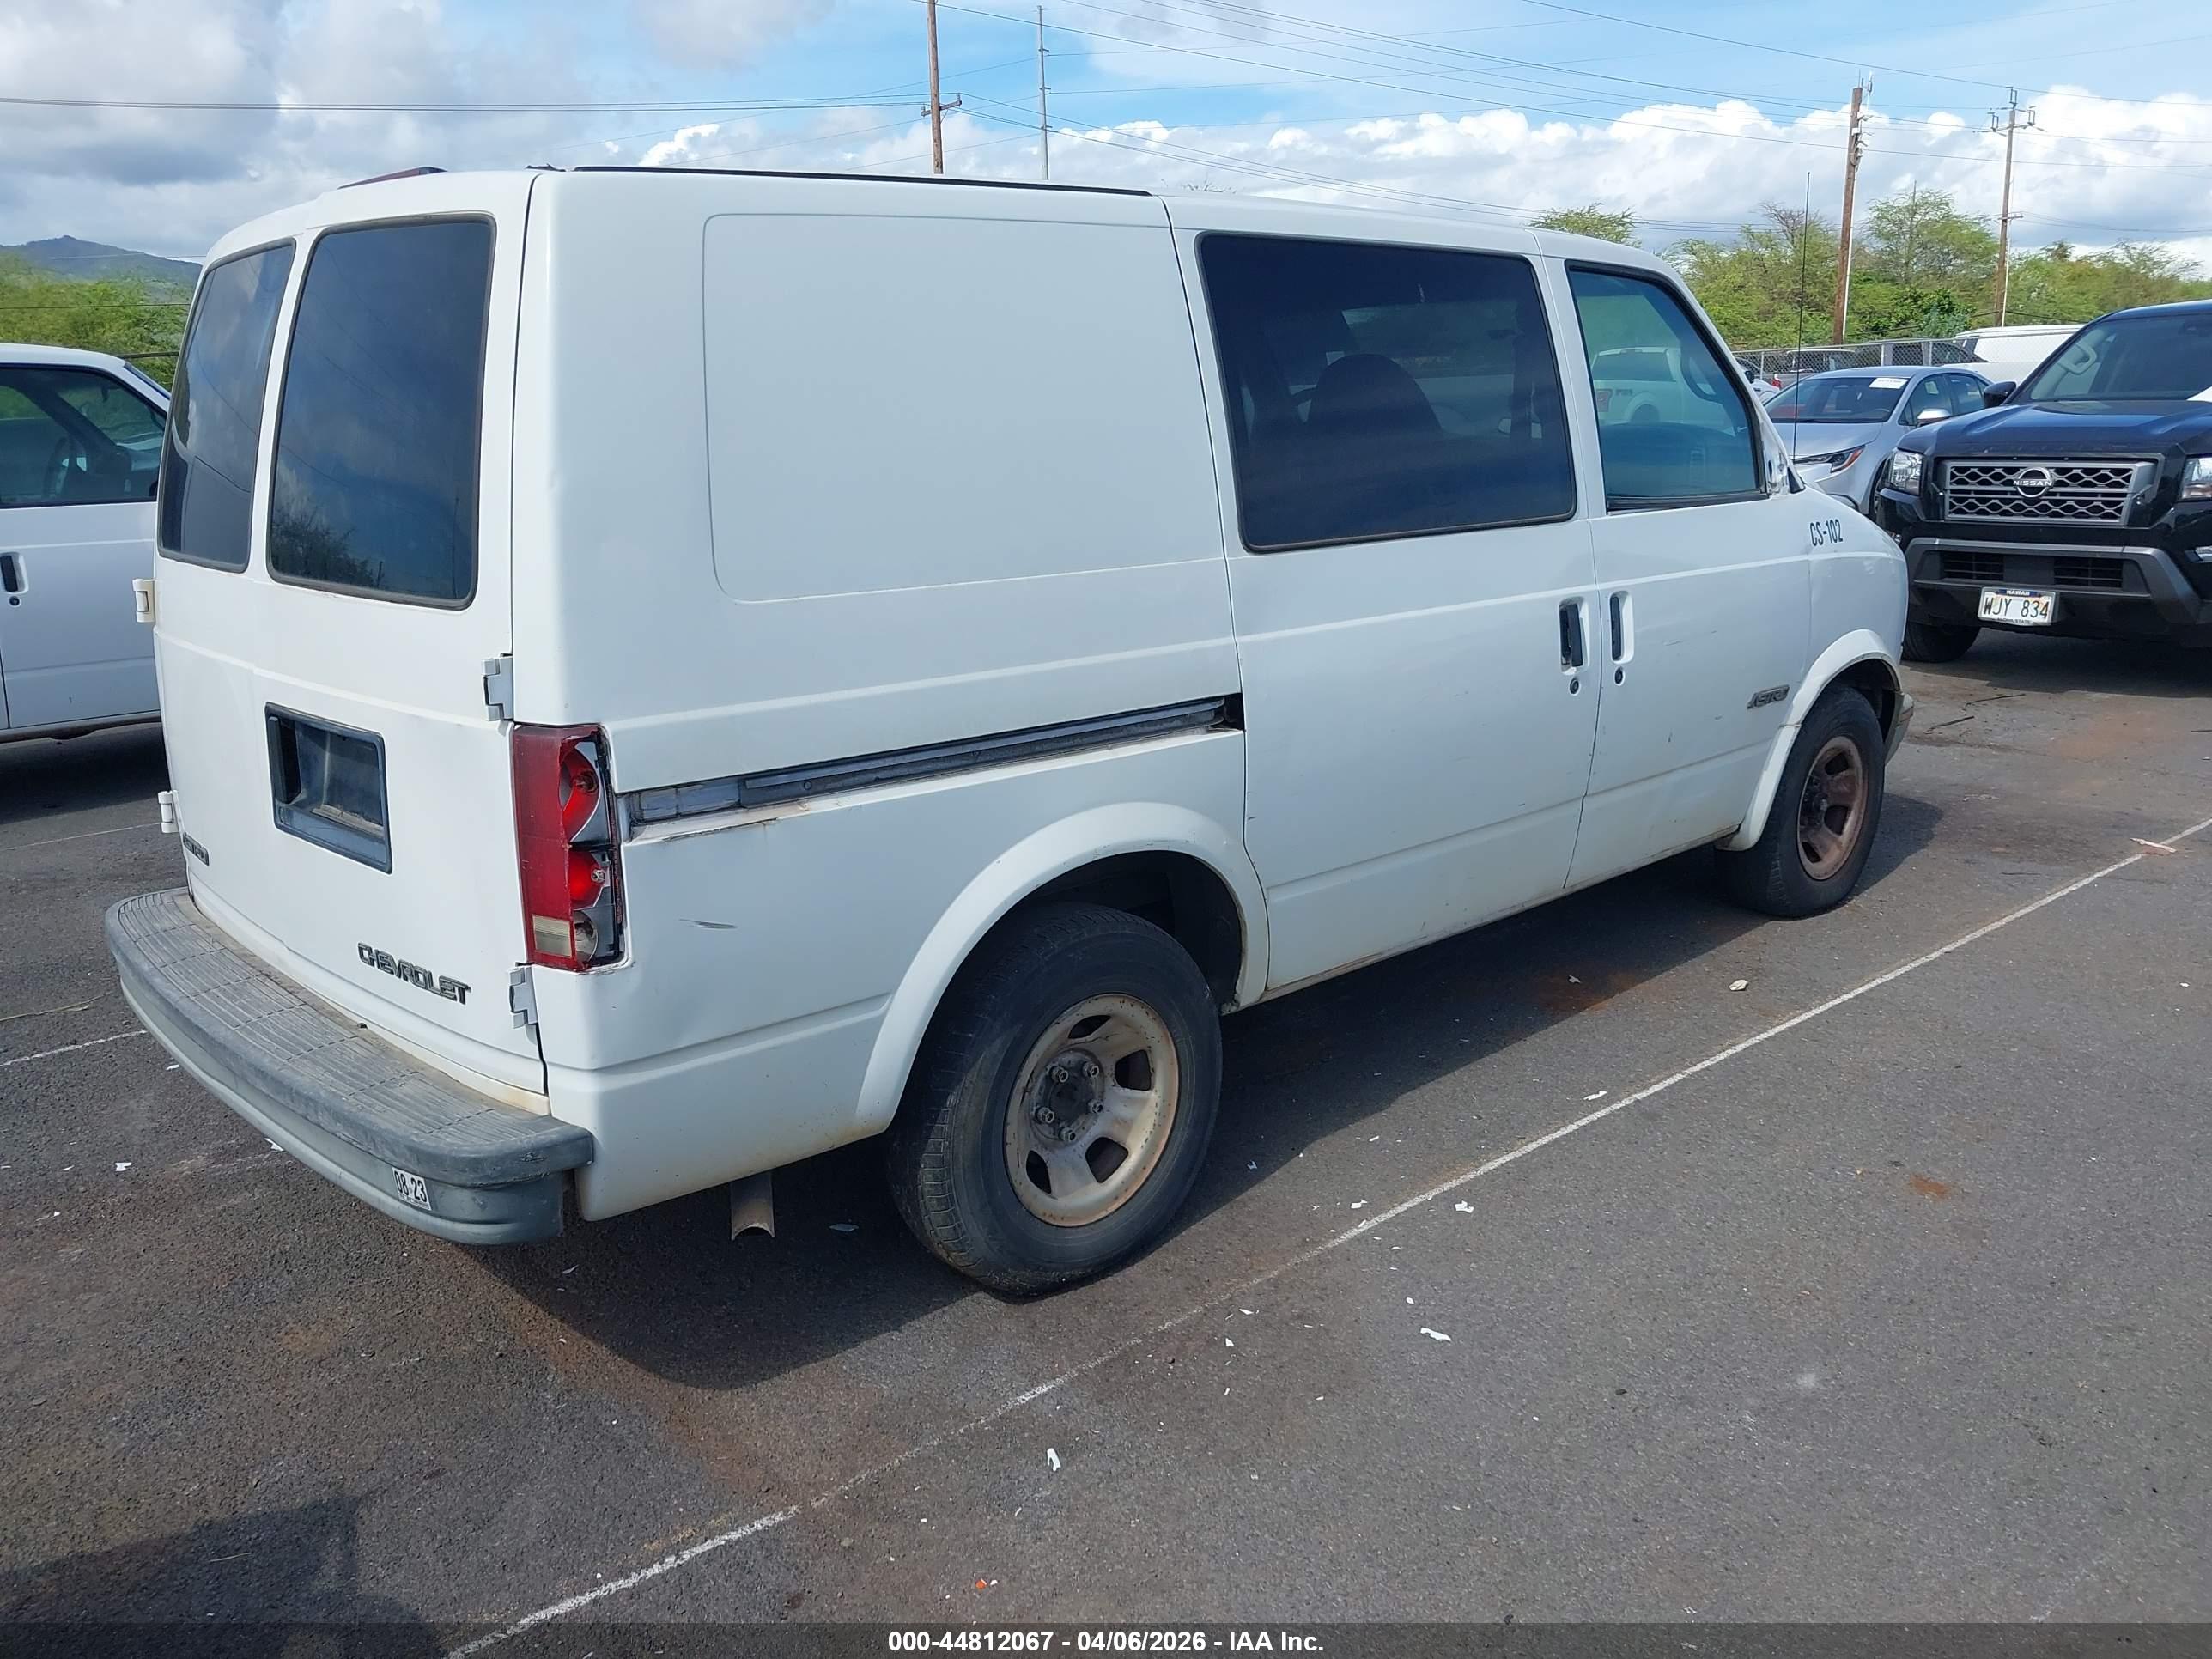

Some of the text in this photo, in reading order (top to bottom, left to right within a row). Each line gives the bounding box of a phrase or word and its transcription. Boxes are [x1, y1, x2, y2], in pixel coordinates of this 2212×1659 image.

[1809, 519, 1844, 546] CS-102
[1984, 597, 2050, 619] WJY 834
[357, 942, 471, 1006] CHEVROLET
